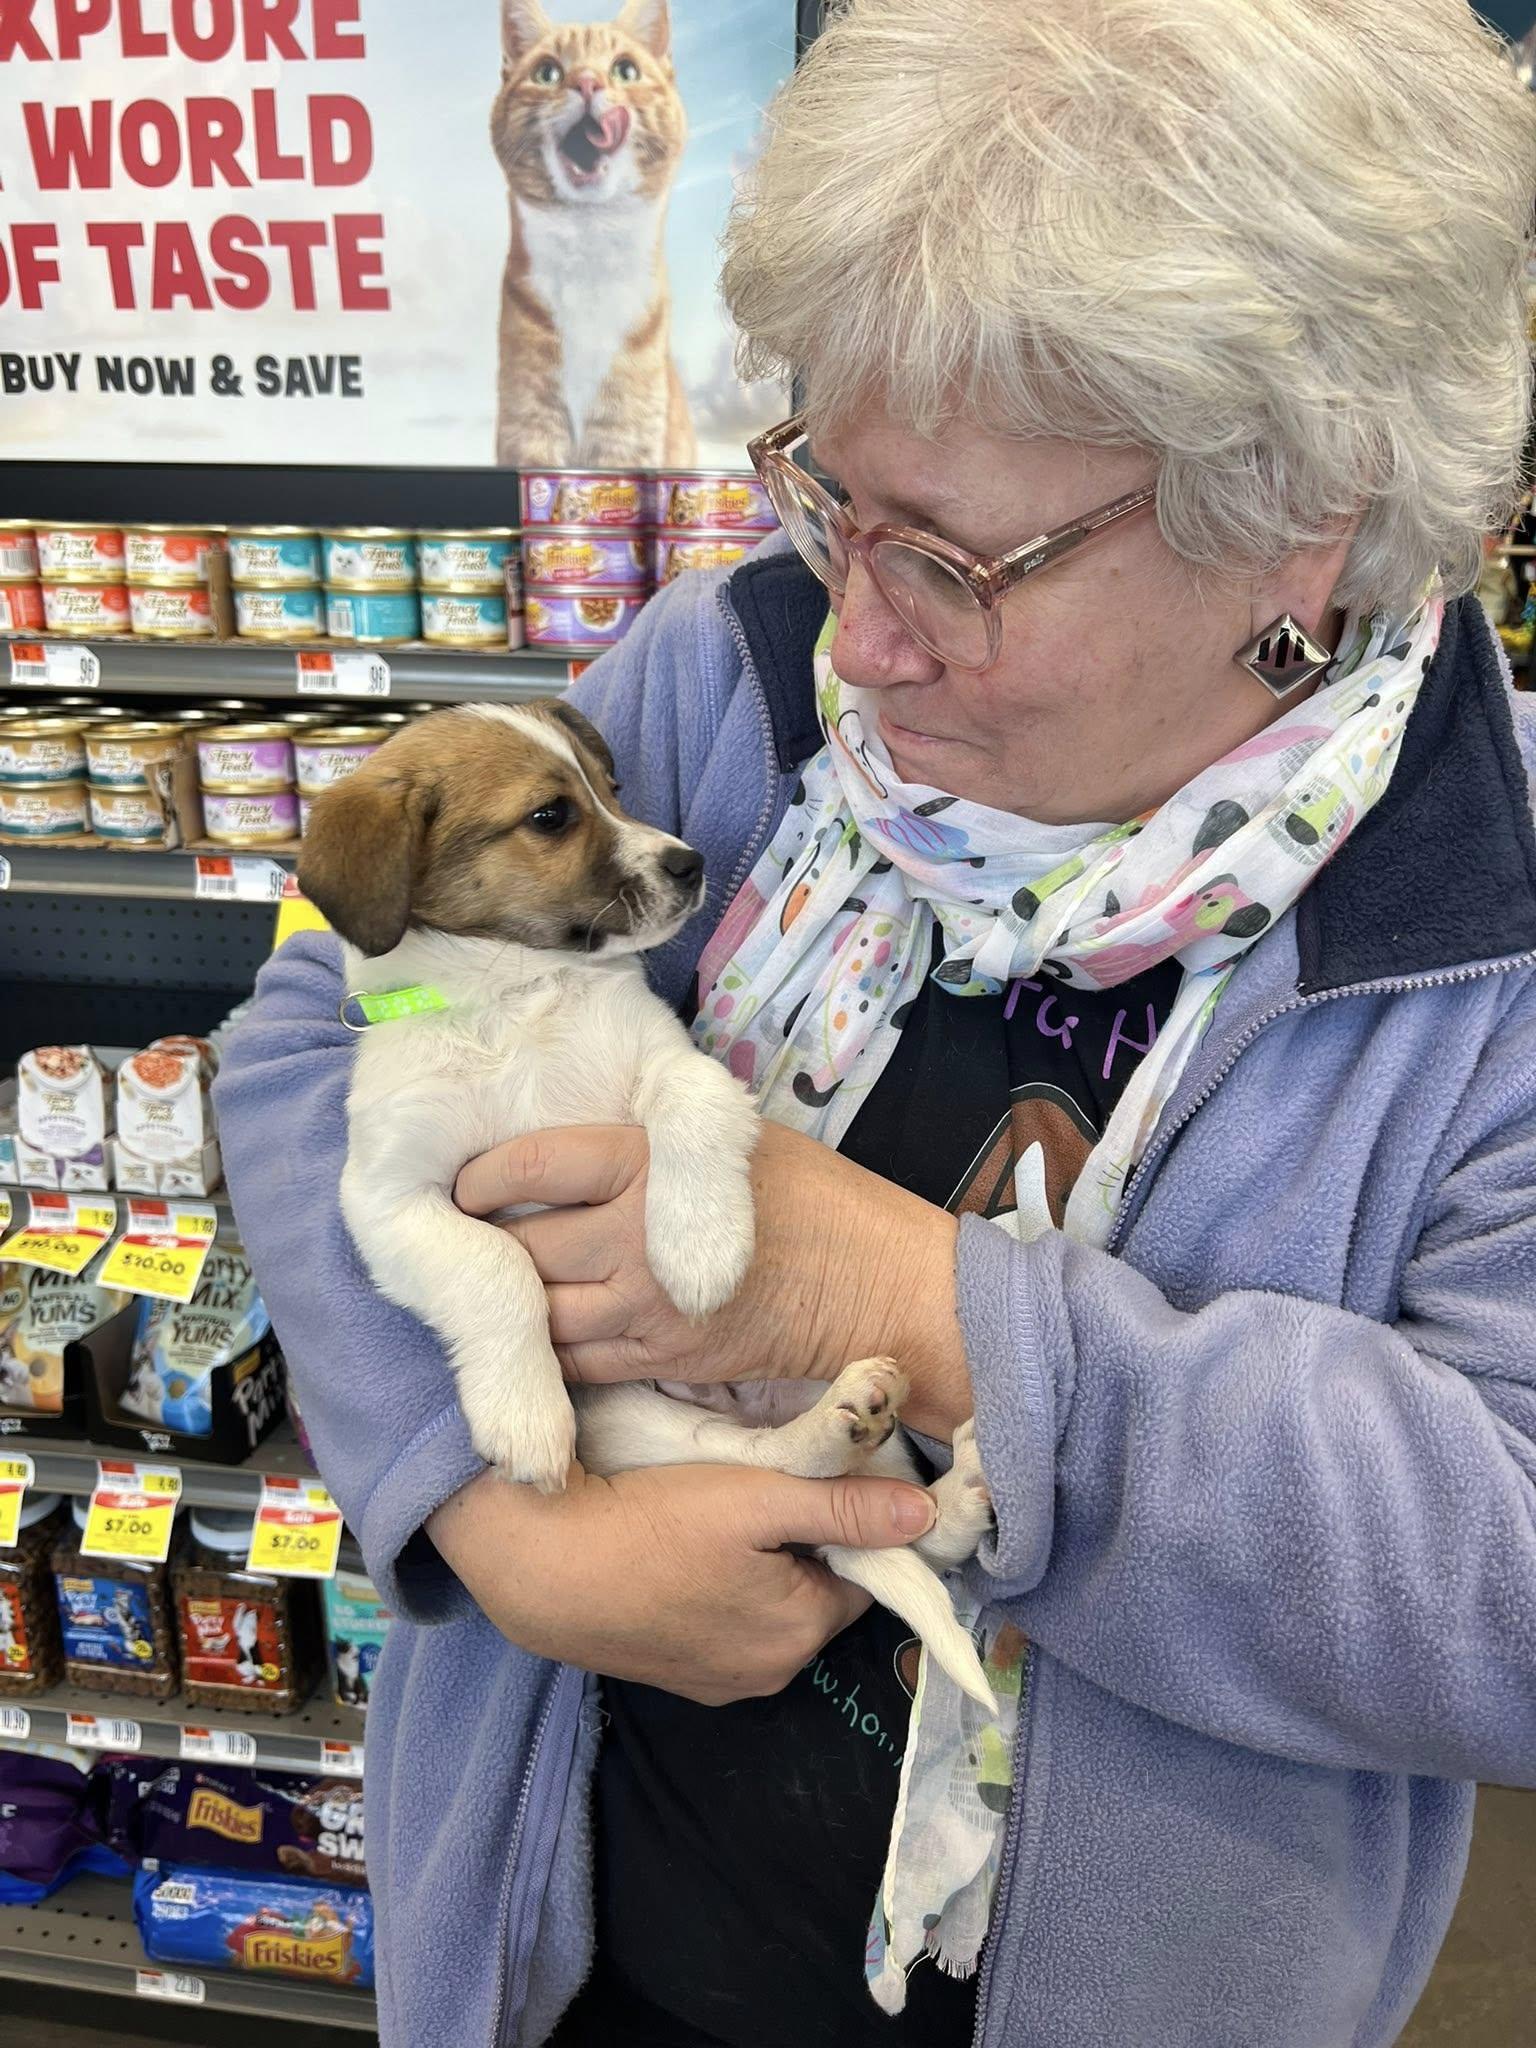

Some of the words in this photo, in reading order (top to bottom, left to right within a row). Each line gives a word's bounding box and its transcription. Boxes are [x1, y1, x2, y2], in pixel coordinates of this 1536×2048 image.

[22, 88, 374, 190] WORLD
[0, 222, 61, 311] F
[85, 214, 392, 312] TASTE
[0, 353, 81, 394] BUY
[96, 356, 196, 396] NOW
[210, 354, 245, 397] &
[256, 355, 364, 398] SAVE
[30, 1302, 96, 1327] YUMS
[104, 1519, 152, 1535] $7.00
[272, 1534, 320, 1550] $7.00
[194, 1796, 257, 1836] Friskies
[252, 1940, 338, 1970] Friskies
